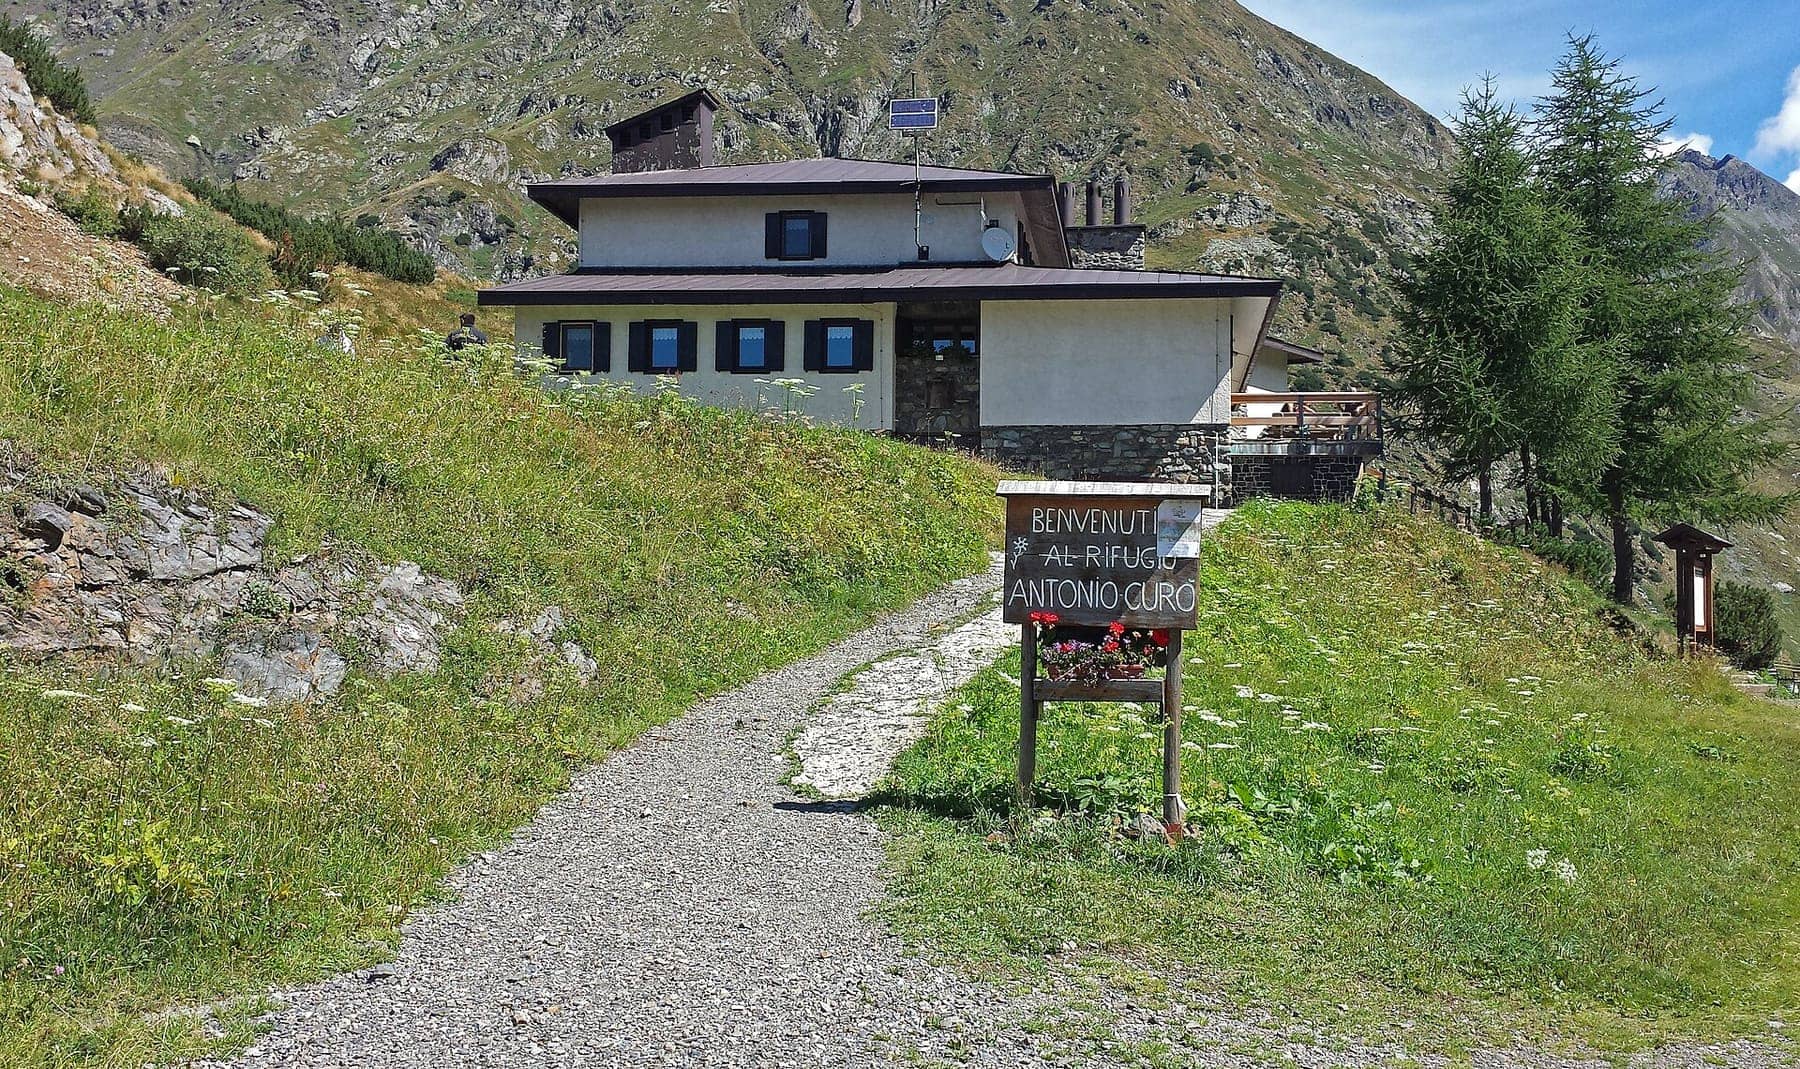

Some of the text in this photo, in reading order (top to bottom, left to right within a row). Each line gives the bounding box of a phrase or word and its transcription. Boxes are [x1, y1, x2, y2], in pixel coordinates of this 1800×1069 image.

[1031, 506, 1158, 535] BENVENUTI
[1044, 544, 1074, 568] AL
[1007, 576, 1118, 610] ANTONIO
